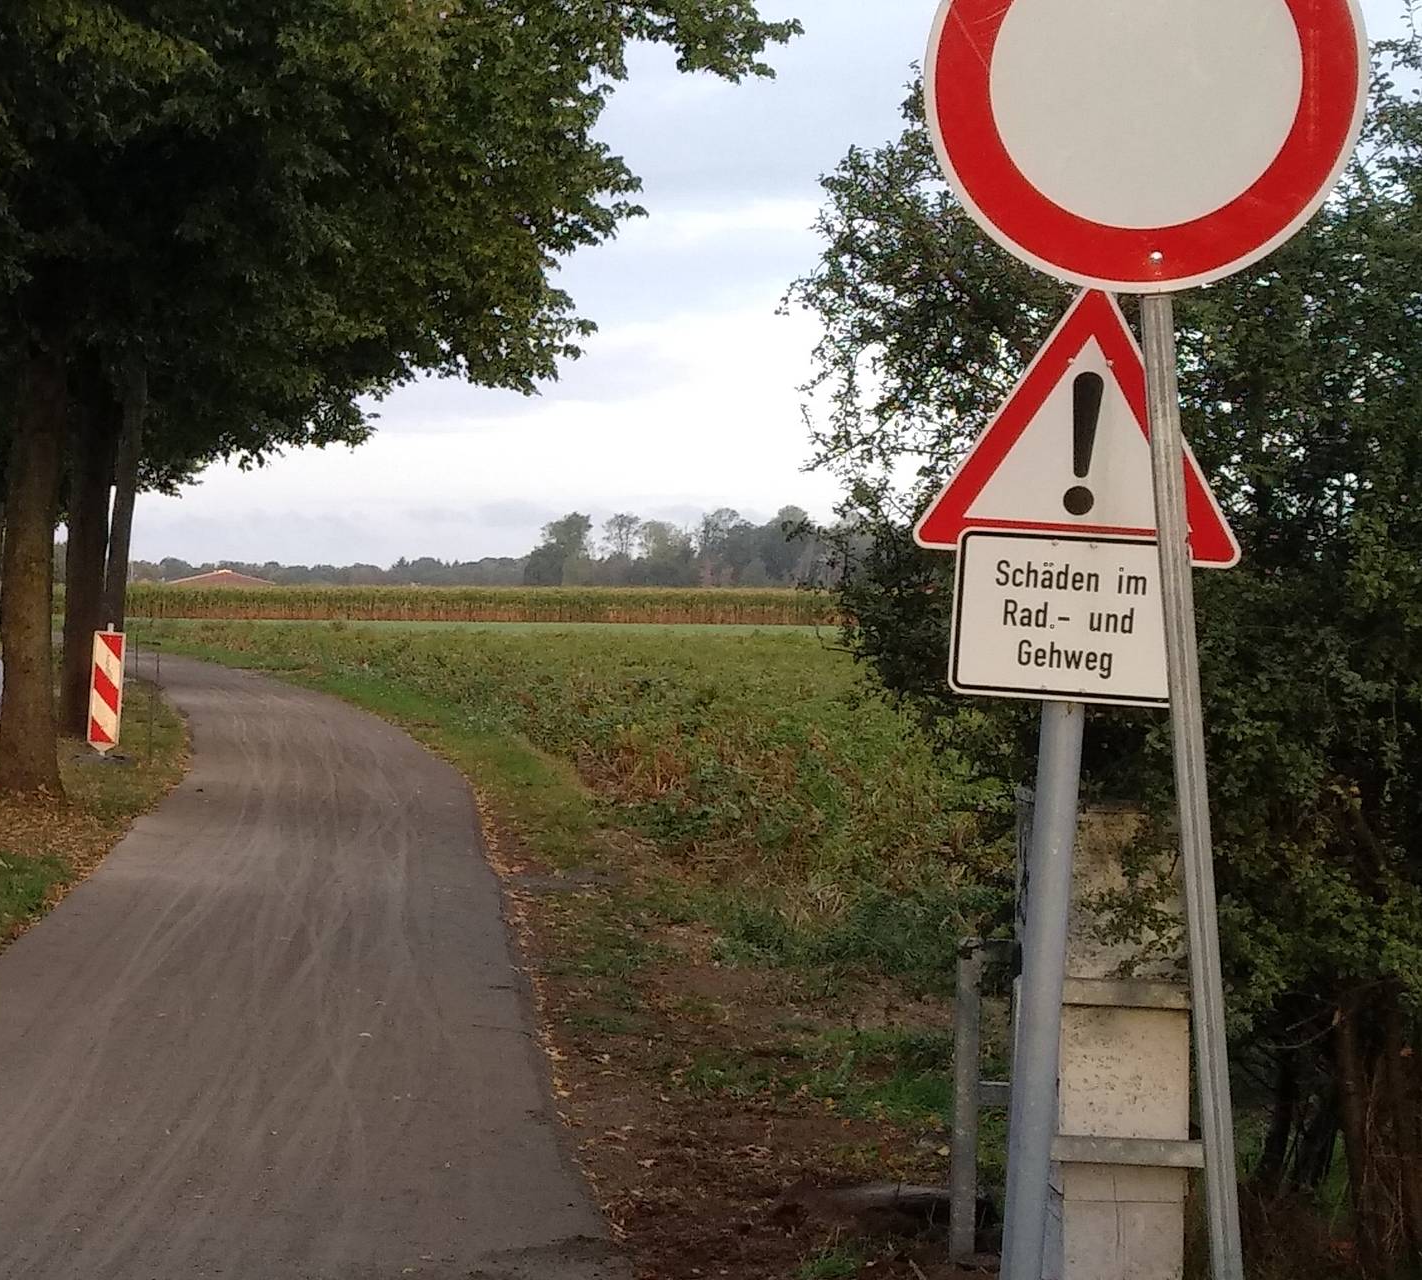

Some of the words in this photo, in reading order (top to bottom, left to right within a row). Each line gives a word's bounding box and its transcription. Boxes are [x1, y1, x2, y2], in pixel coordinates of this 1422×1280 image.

[995, 559, 1100, 593] Schäden
[1117, 567, 1147, 596] im
[1089, 607, 1135, 634] und
[1017, 639, 1113, 680] Gehweg
